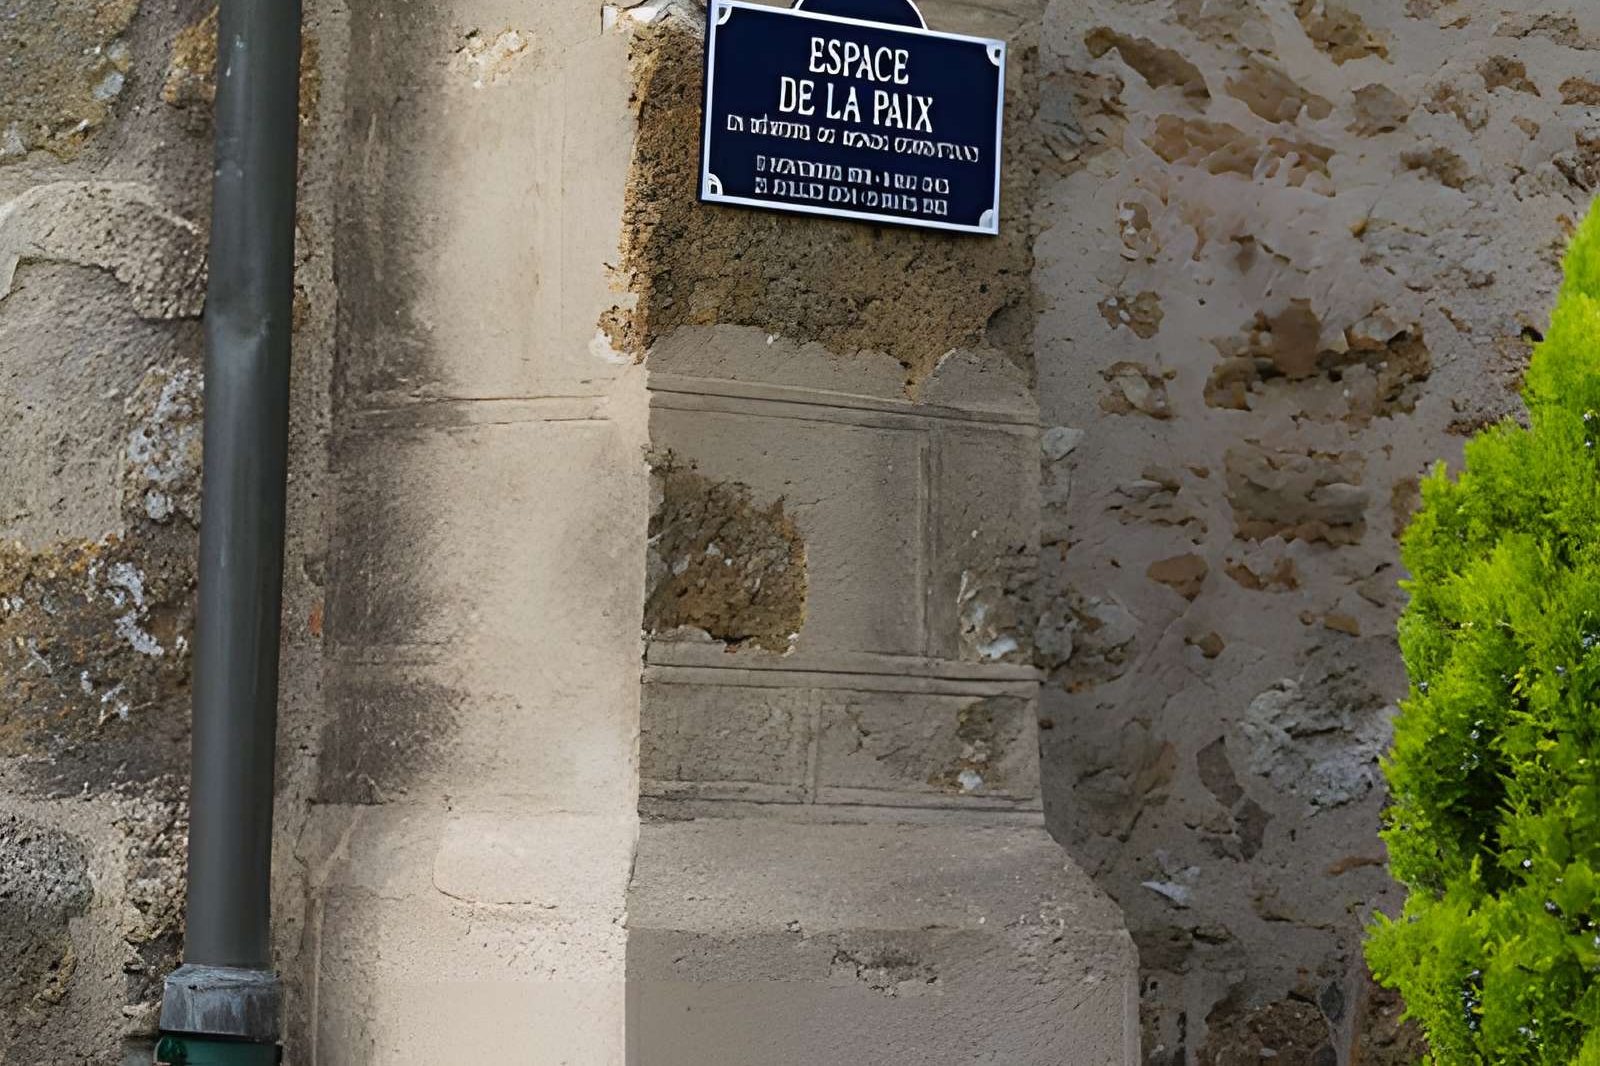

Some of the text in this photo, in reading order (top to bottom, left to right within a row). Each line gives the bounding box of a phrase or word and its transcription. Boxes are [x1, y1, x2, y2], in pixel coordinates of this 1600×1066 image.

[808, 36, 910, 85] ESPACE
[778, 76, 934, 134] DE LA PAIX
